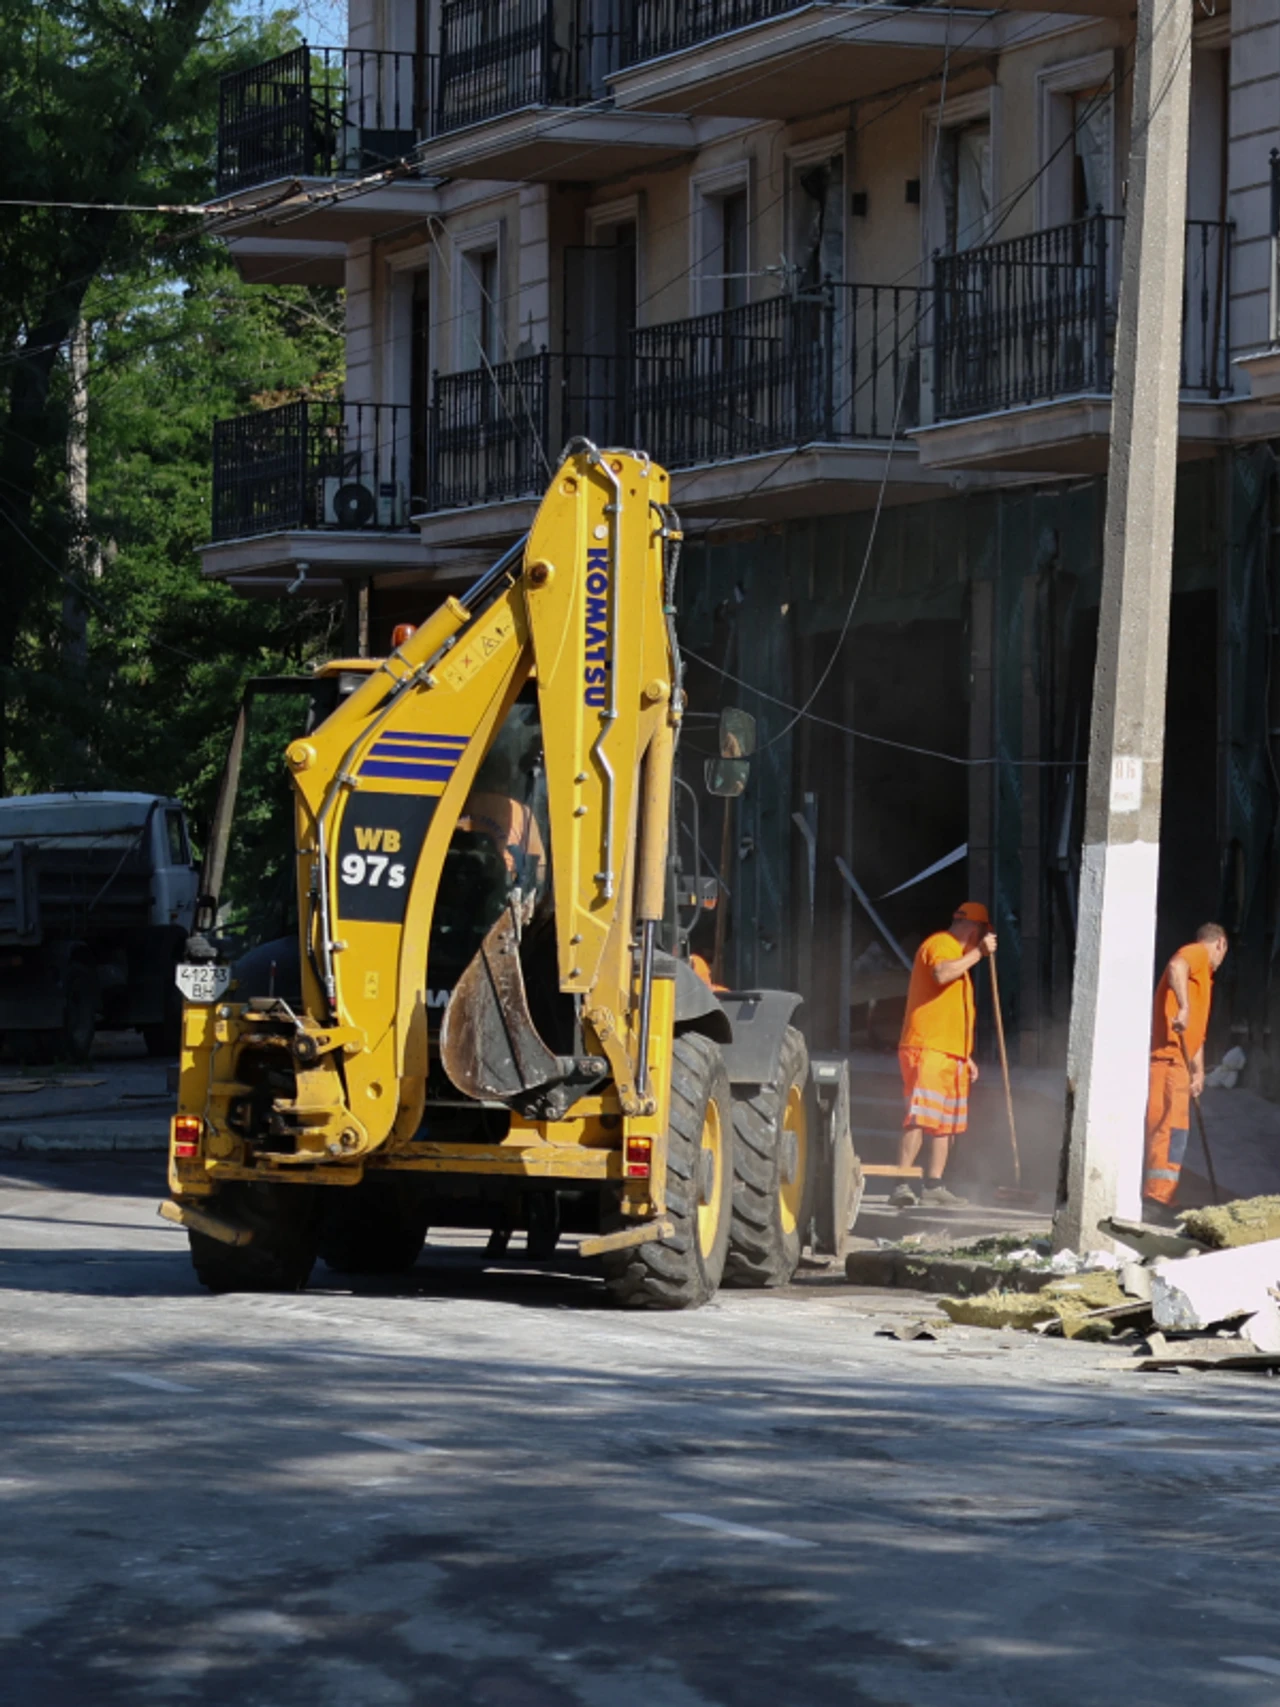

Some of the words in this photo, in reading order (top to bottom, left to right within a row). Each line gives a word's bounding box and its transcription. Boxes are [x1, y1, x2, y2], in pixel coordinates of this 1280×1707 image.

[584, 548, 608, 707] KOMATSU
[354, 826, 402, 853] WB
[181, 968, 227, 983] 41273
